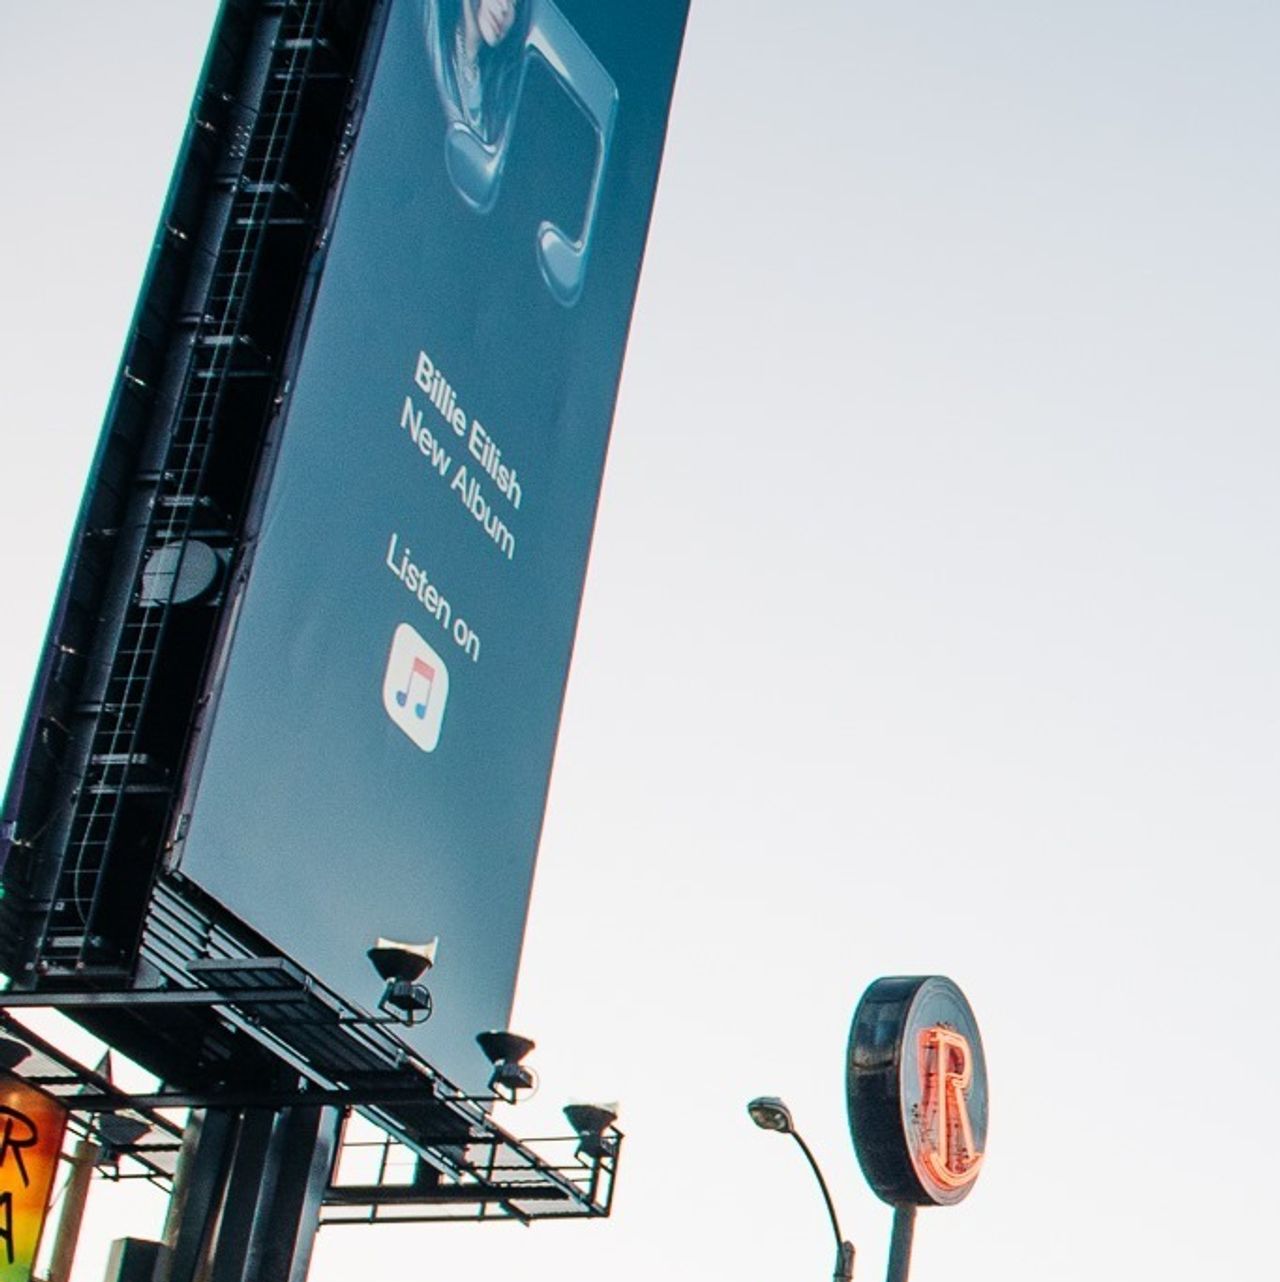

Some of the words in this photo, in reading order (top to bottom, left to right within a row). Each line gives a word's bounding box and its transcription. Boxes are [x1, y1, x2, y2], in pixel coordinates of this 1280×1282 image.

[400, 395, 451, 476] New
[450, 464, 516, 560] Album
[414, 350, 467, 436] Billie
[468, 419, 522, 509] Eilish
[386, 532, 452, 629] Listen
[453, 617, 481, 663] on
